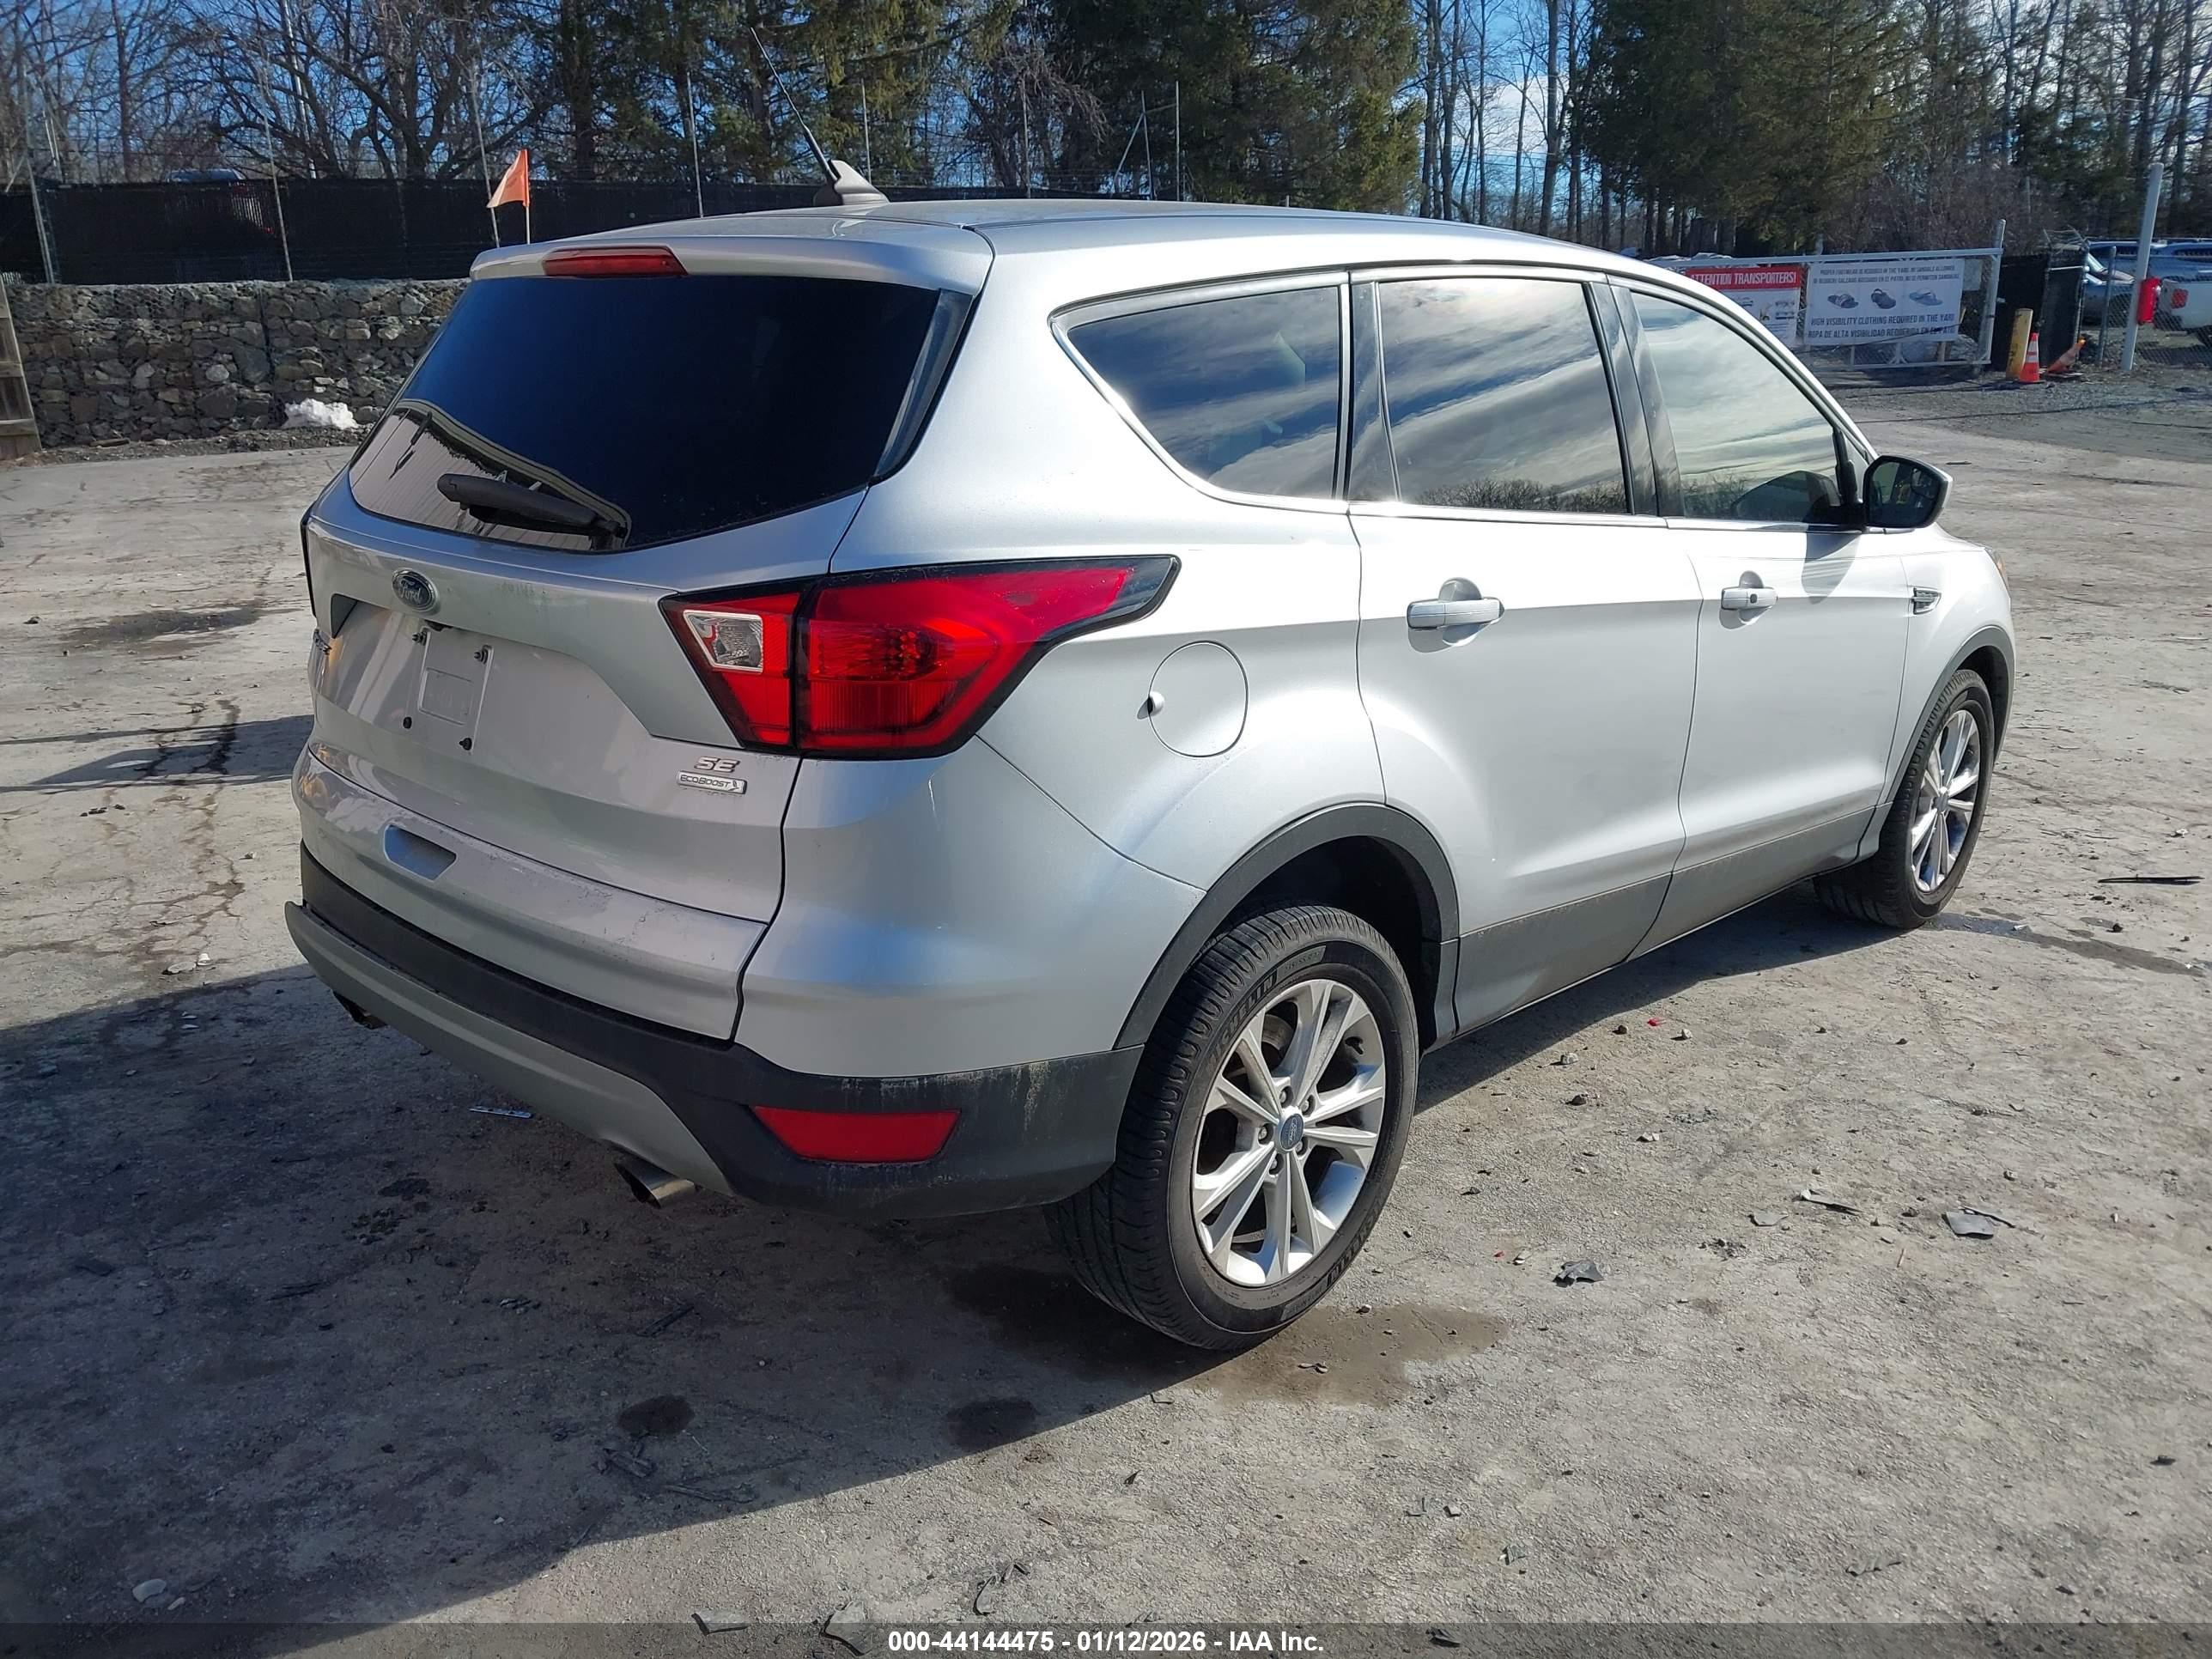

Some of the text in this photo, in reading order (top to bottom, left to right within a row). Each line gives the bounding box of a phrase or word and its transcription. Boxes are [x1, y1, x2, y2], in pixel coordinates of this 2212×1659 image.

[1691, 271, 1796, 285] TTENTION TRANSPORTERS!
[1826, 316, 1857, 325] VISIBILITY
[1858, 315, 1887, 325] CLOTHING
[1888, 314, 1917, 324] REQUIRED
[1833, 329, 1849, 337] ALTA
[694, 756, 740, 773] SE
